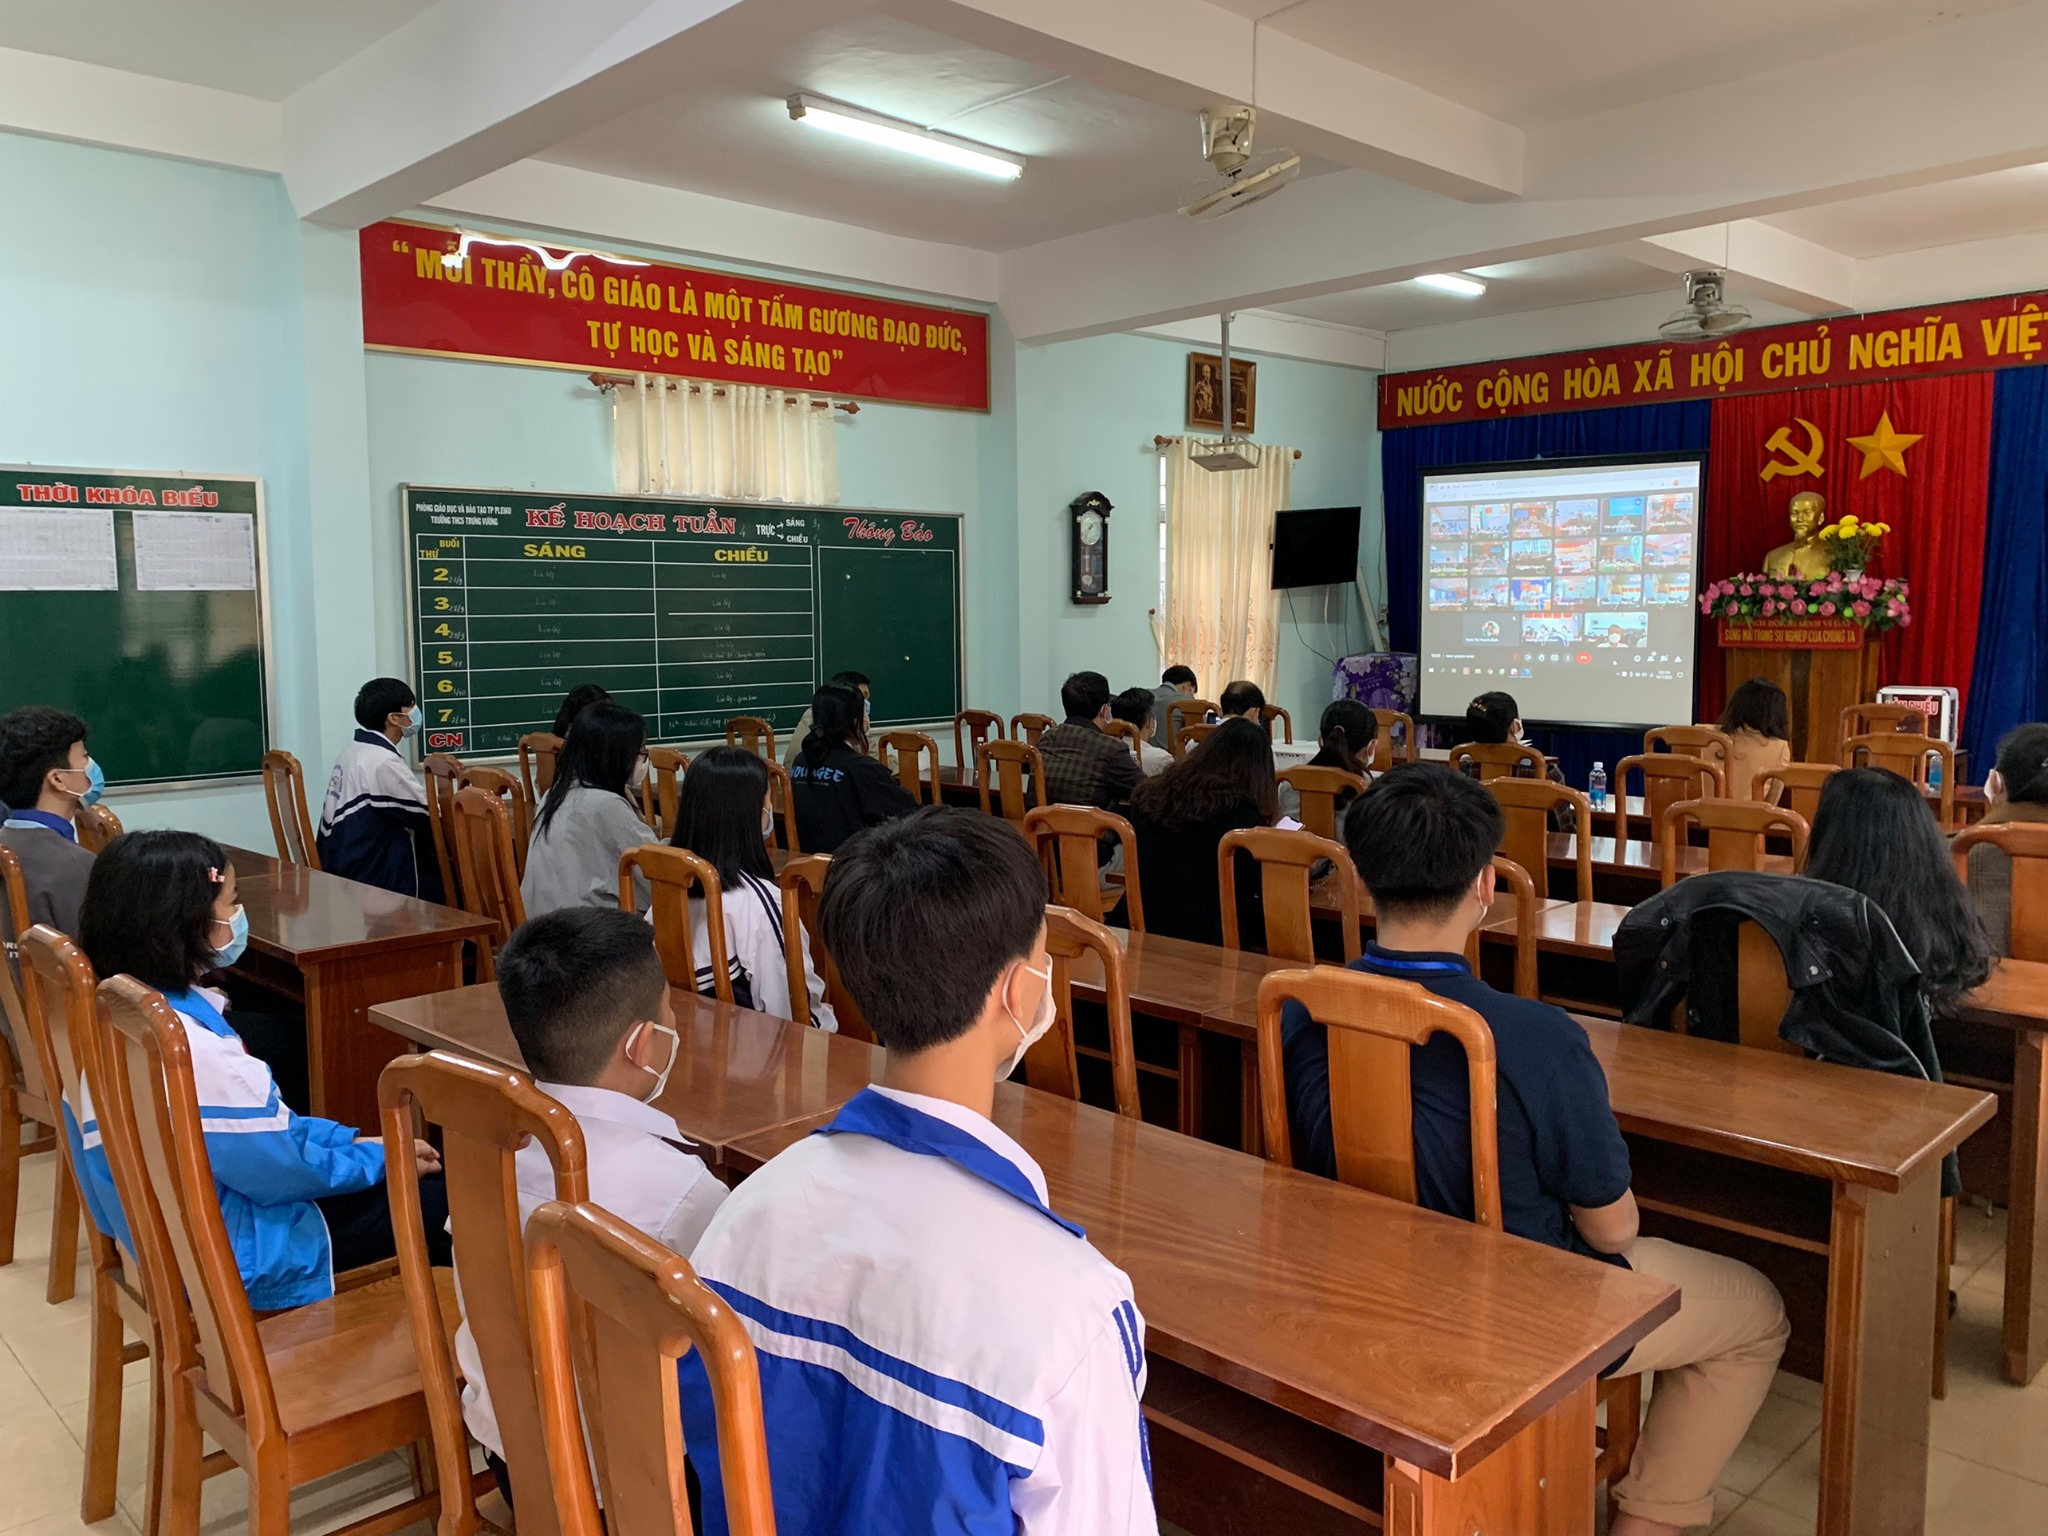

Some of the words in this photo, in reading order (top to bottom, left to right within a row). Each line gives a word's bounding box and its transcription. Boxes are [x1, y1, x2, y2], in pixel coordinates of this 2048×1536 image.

[481, 253, 555, 299] THẦY,
[561, 265, 595, 301] CÔ
[603, 274, 661, 311] GIÁO
[668, 281, 698, 316] LÀ
[704, 288, 753, 328] MỘT
[758, 293, 803, 330] TẤM
[809, 306, 878, 341] GƯƠNG
[883, 318, 920, 352] ĐẠO
[925, 320, 967, 356] ĐỨC,
[586, 320, 621, 358] TỰ
[630, 326, 679, 363] HỌC
[687, 329, 717, 362] VÀ
[724, 334, 785, 371] SÁNG
[1397, 374, 1462, 417] NƯỚC
[1476, 368, 1549, 414] CỘNG
[1564, 357, 1620, 400] HÒA
[1632, 348, 1674, 393] XÃ
[1690, 341, 1743, 392] HỘI
[1761, 325, 1831, 379] CHỦ
[1849, 315, 1963, 371] NGHĨA
[1980, 303, 2048, 360] VIỆ
[16, 482, 79, 503] THỜI
[85, 485, 156, 506] KHÓA
[162, 486, 219, 507] BIỂU
[525, 502, 566, 528] KẾ
[574, 511, 666, 534] HOẠCH
[673, 507, 736, 534] TUẦN
[785, 517, 805, 527] SÁNG
[755, 523, 775, 538] TRỰC
[843, 517, 895, 546] Thông
[900, 520, 933, 541] Báo
[439, 536, 459, 548] BUỔI
[419, 547, 439, 558] THỨ
[523, 541, 586, 559] SÁNG
[714, 545, 768, 562] CHIỀU
[433, 567, 449, 581] 2
[433, 596, 449, 610] 3
[434, 623, 450, 636] 4
[437, 651, 453, 664] 5
[437, 679, 453, 693] 6
[438, 708, 453, 722] 7
[428, 732, 463, 748] CN
